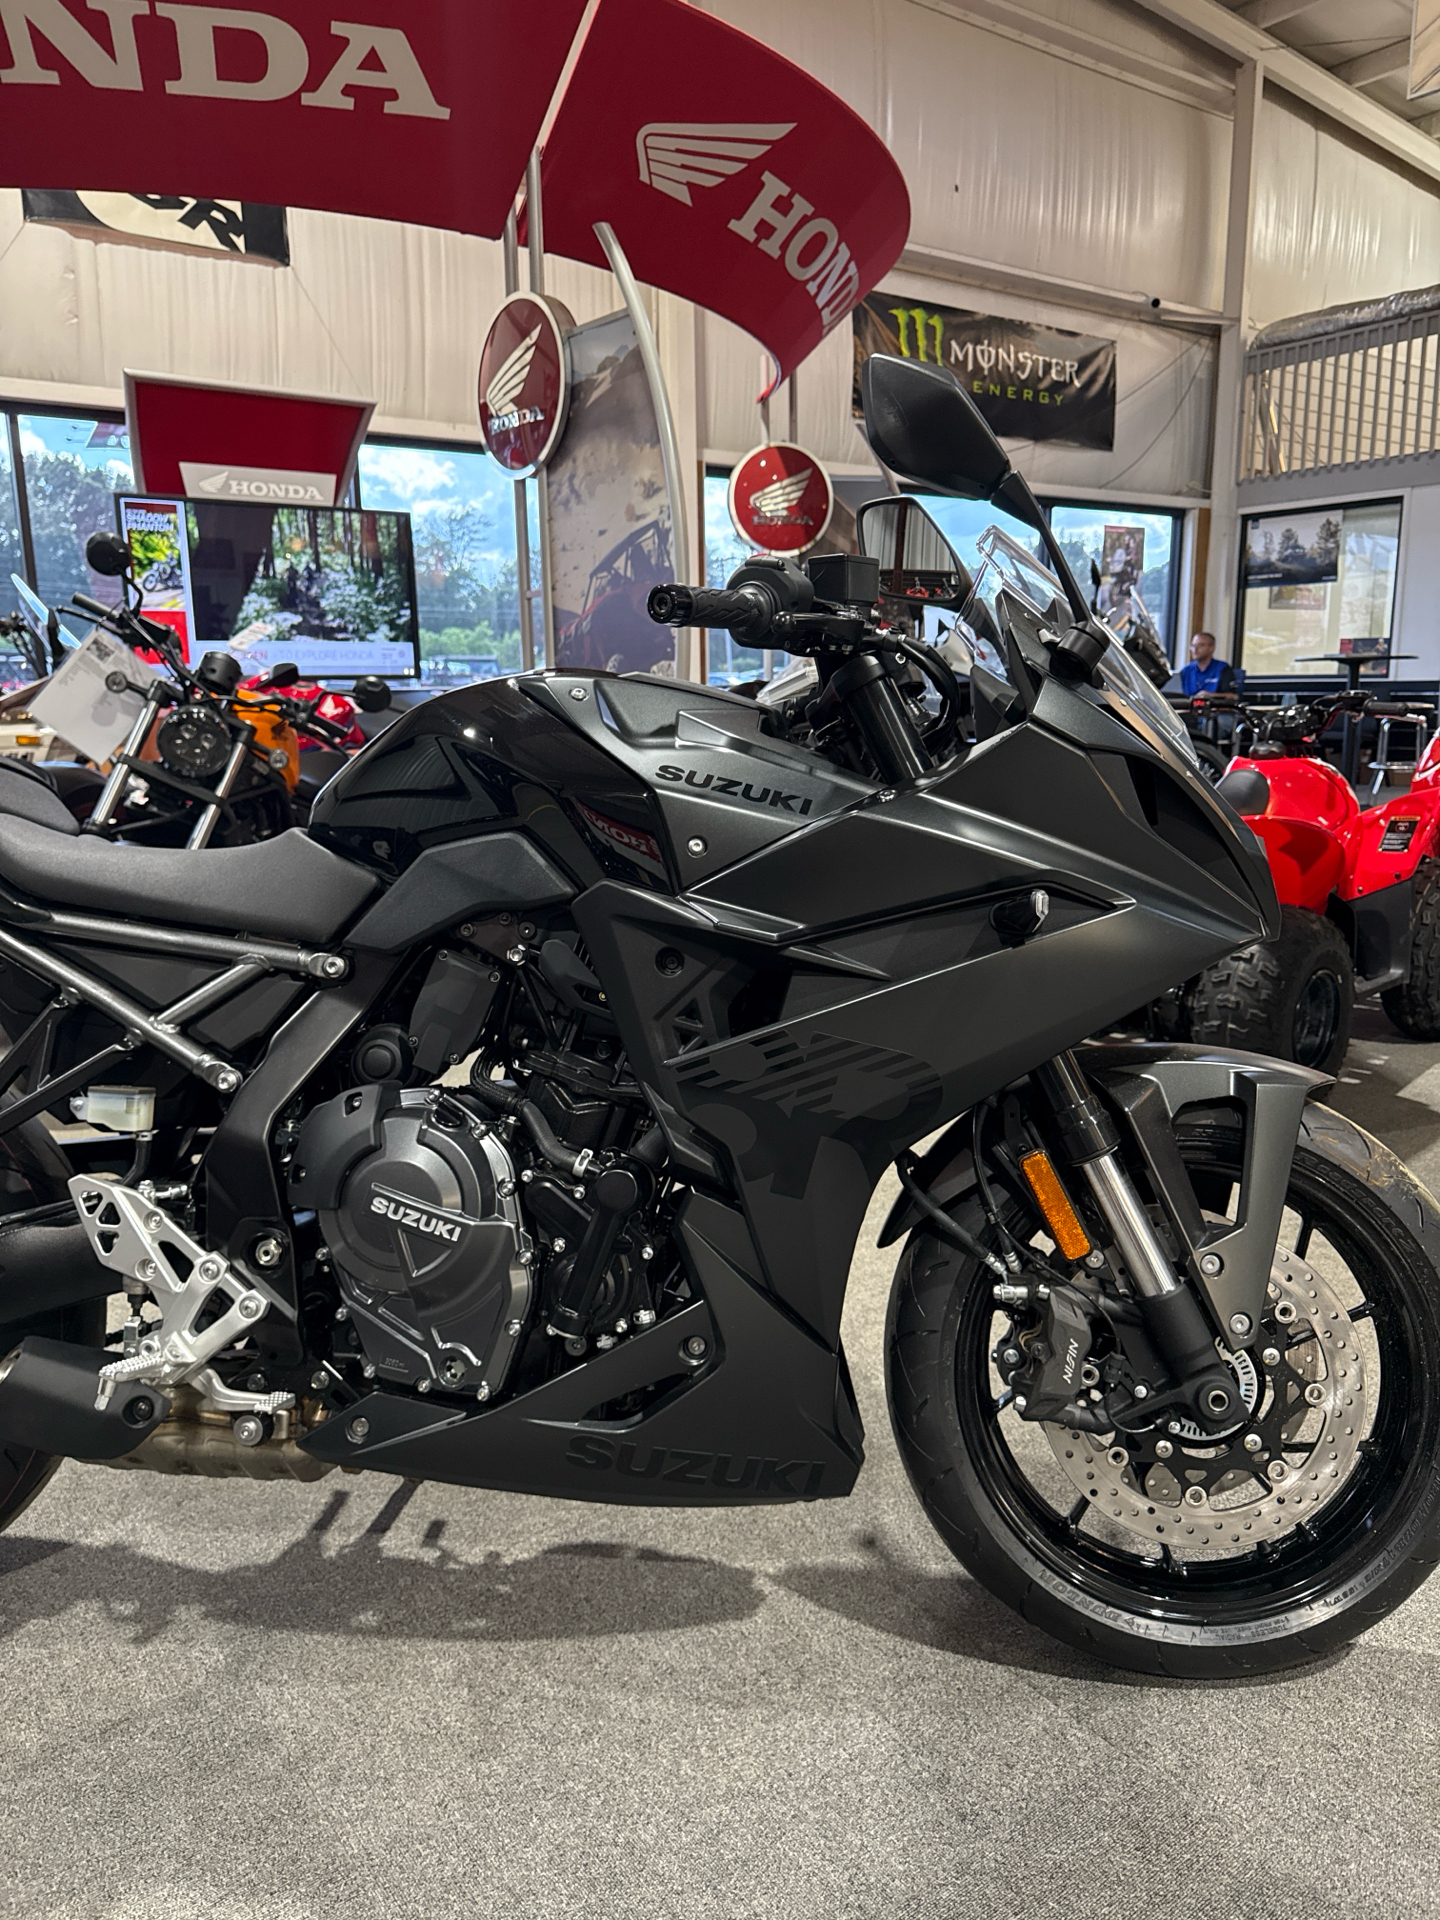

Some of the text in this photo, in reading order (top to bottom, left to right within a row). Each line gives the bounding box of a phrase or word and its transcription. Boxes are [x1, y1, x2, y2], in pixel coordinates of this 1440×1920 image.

[727, 170, 860, 337] HOND
[972, 380, 1064, 406] ENERGY
[488, 405, 545, 435] HONDA
[228, 479, 324, 500] HONDA
[127, 520, 174, 531] PHANTOM
[655, 764, 814, 816] SUZUKI
[370, 1196, 462, 1242] SUZUKI
[566, 1434, 827, 1495] SUZUKI
[1037, 1569, 1122, 1622] DUNLOP
